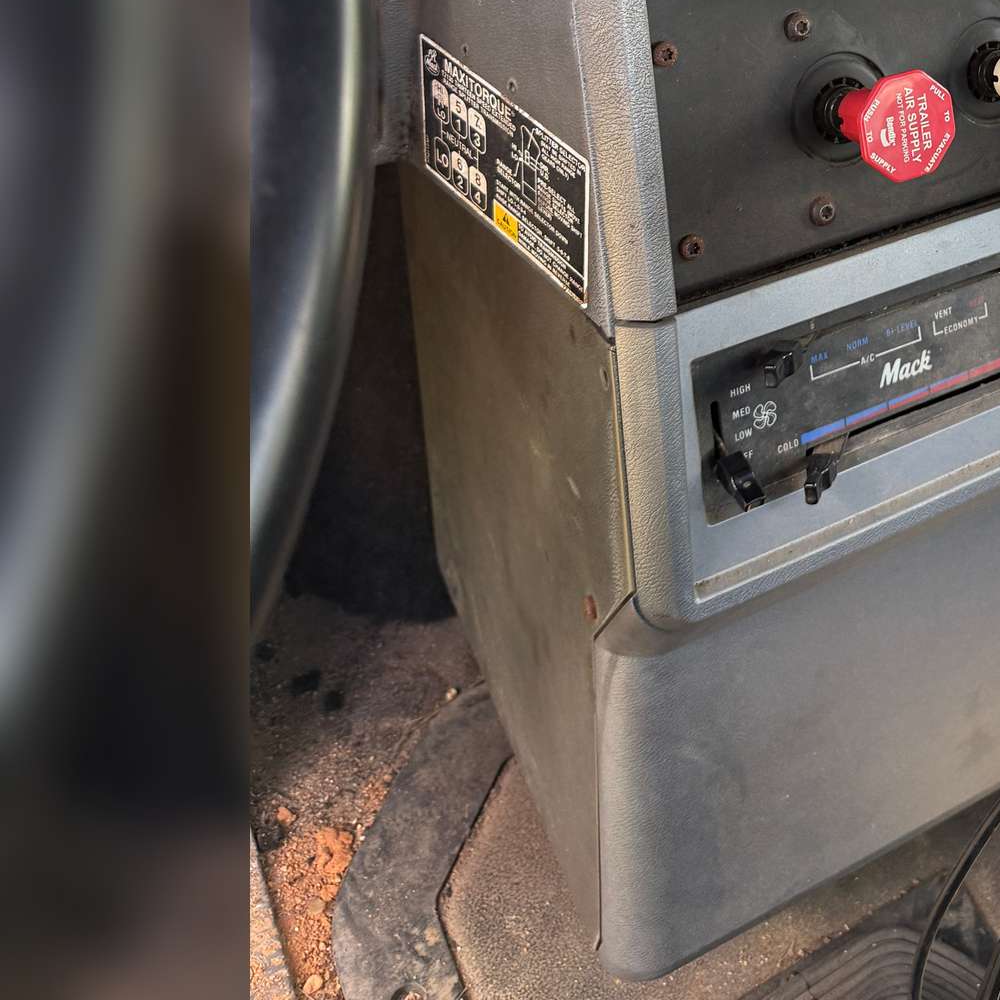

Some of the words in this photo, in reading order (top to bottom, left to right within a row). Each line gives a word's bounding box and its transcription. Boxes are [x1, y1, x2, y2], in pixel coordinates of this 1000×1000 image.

[443, 58, 512, 122] MAXITORQUE
[903, 87, 915, 109] AIR
[929, 84, 946, 101] PULL
[917, 92, 933, 151] TRAILER
[943, 110, 951, 122] TO
[896, 92, 904, 109] NOT
[901, 127, 911, 163] PARKING
[473, 132, 481, 147] 3
[907, 112, 922, 163] SUPPLY
[436, 148, 449, 168] LO
[866, 131, 874, 143] TO
[870, 152, 897, 175] SUPPLY
[923, 132, 951, 173] EVACUATE
[457, 175, 464, 189] 2
[934, 306, 952, 320] VENT
[943, 316, 978, 335] ECONOMY
[846, 336, 870, 350] NORM
[810, 351, 829, 363] MAX
[860, 353, 875, 365] A/C
[880, 349, 933, 389] Mack
[730, 383, 751, 398] HIGH
[732, 406, 751, 420] MED
[734, 427, 752, 442] LOW
[777, 438, 799, 454] COLD
